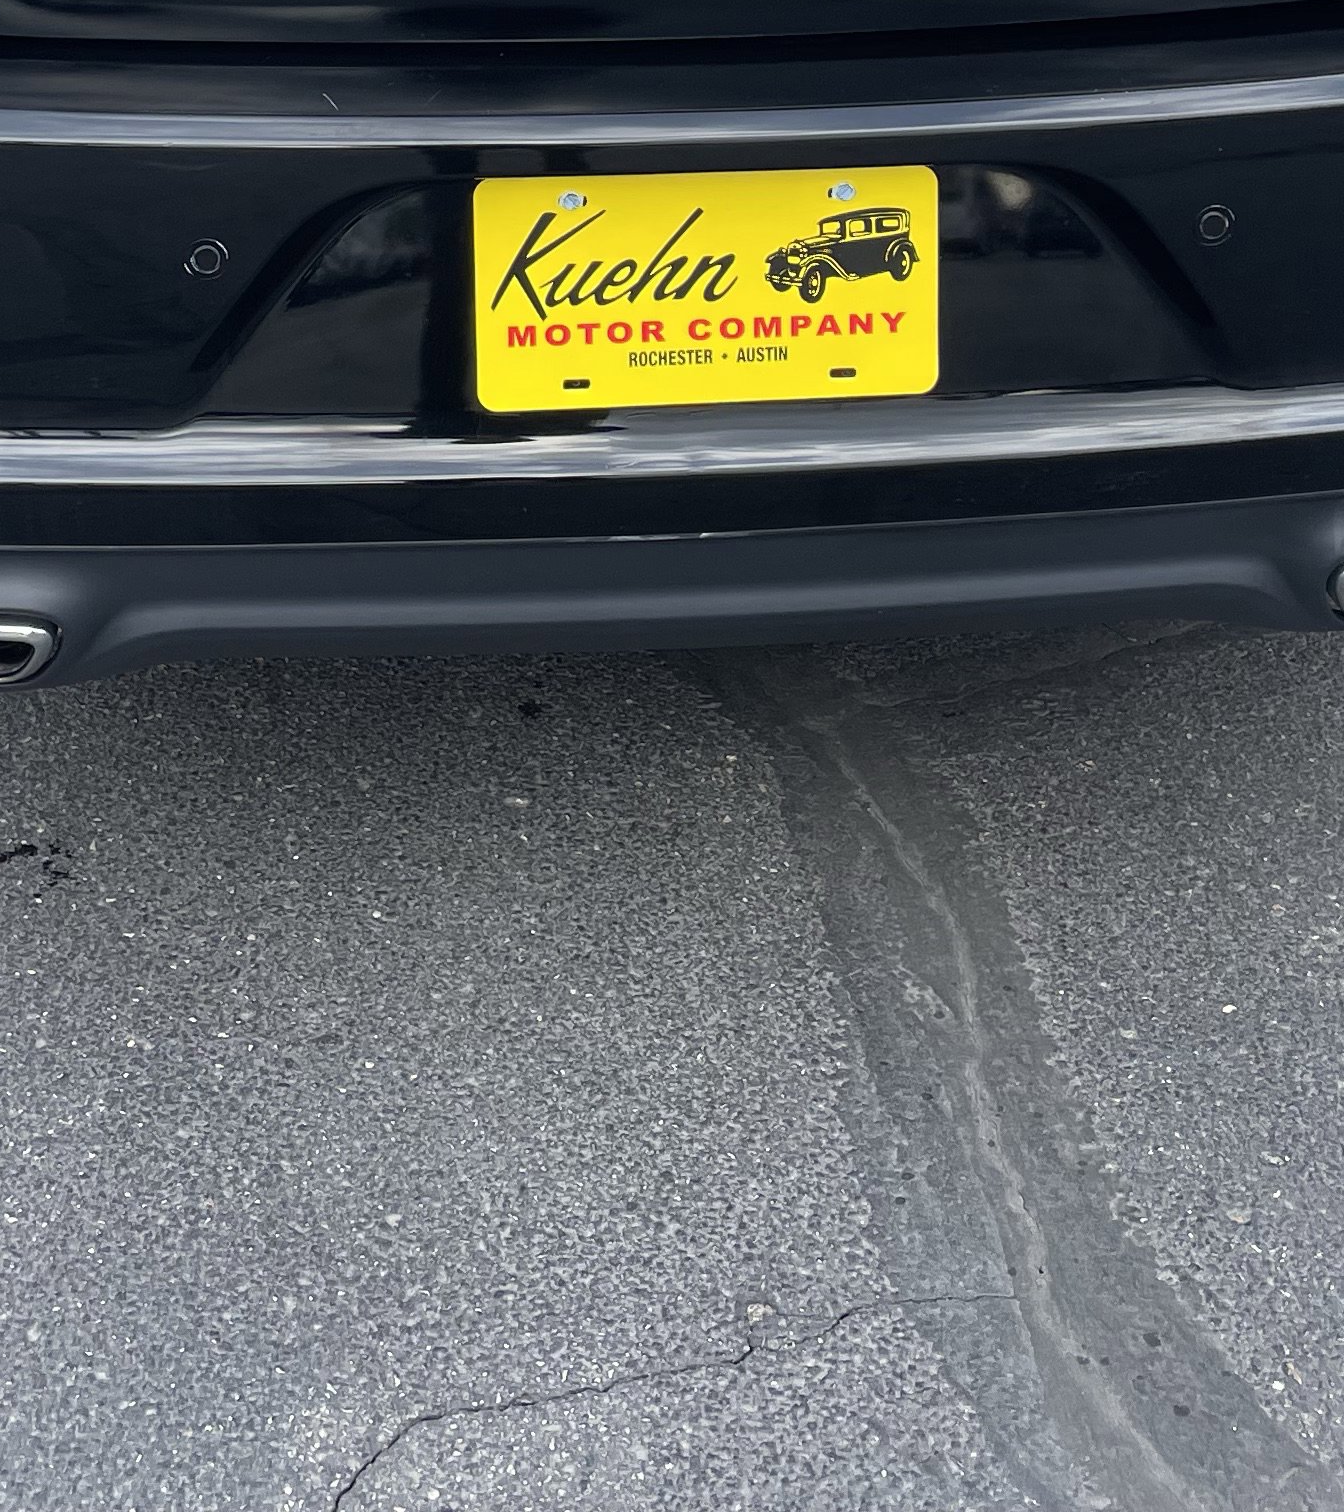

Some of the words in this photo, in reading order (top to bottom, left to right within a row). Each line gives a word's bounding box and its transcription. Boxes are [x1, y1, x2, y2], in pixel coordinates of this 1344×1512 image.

[491, 207, 738, 321] Kuehn
[507, 320, 665, 348] MOTOR
[688, 311, 907, 341] COMPANY
[628, 349, 713, 368] ROCHESTER
[736, 346, 788, 364] AUSTIN
